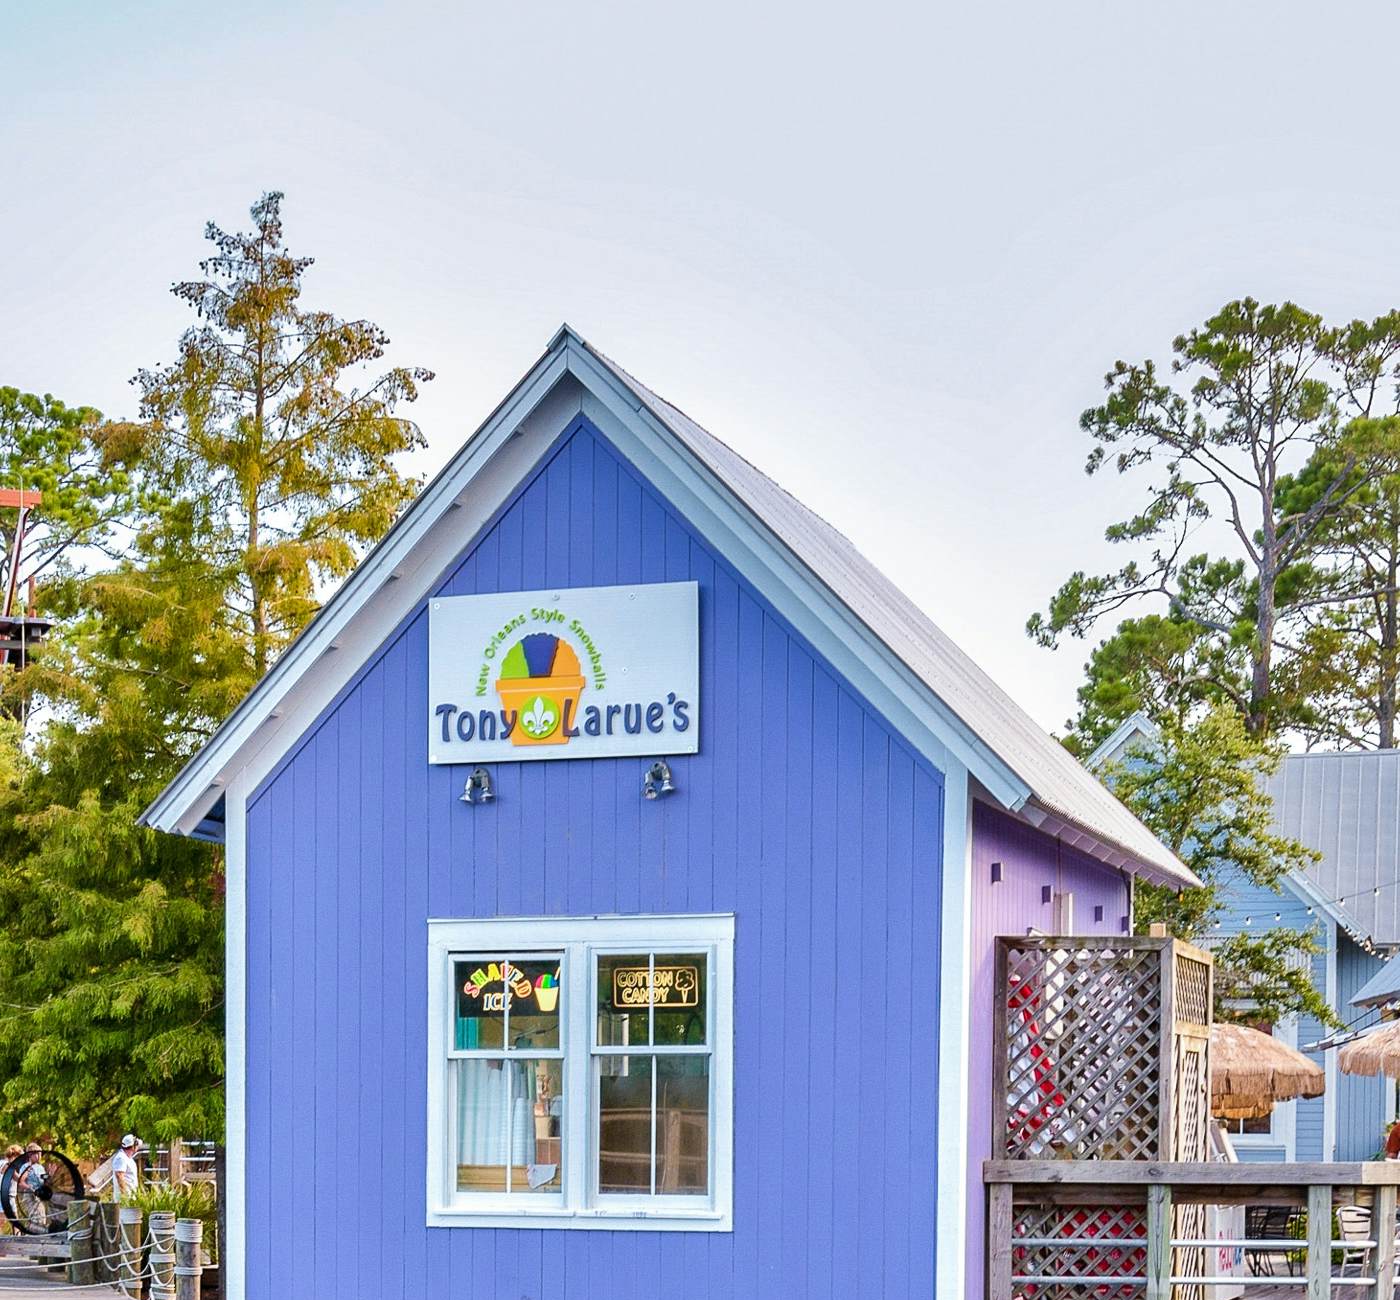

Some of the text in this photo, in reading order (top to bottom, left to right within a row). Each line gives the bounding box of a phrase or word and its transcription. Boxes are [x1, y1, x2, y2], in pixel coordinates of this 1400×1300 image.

[475, 607, 607, 697] New Orleans Style Snowballs
[435, 691, 690, 742] Tony Larue's
[617, 970, 673, 987] COTTON
[483, 992, 513, 1011] ICE
[622, 987, 669, 1003] CANDY
